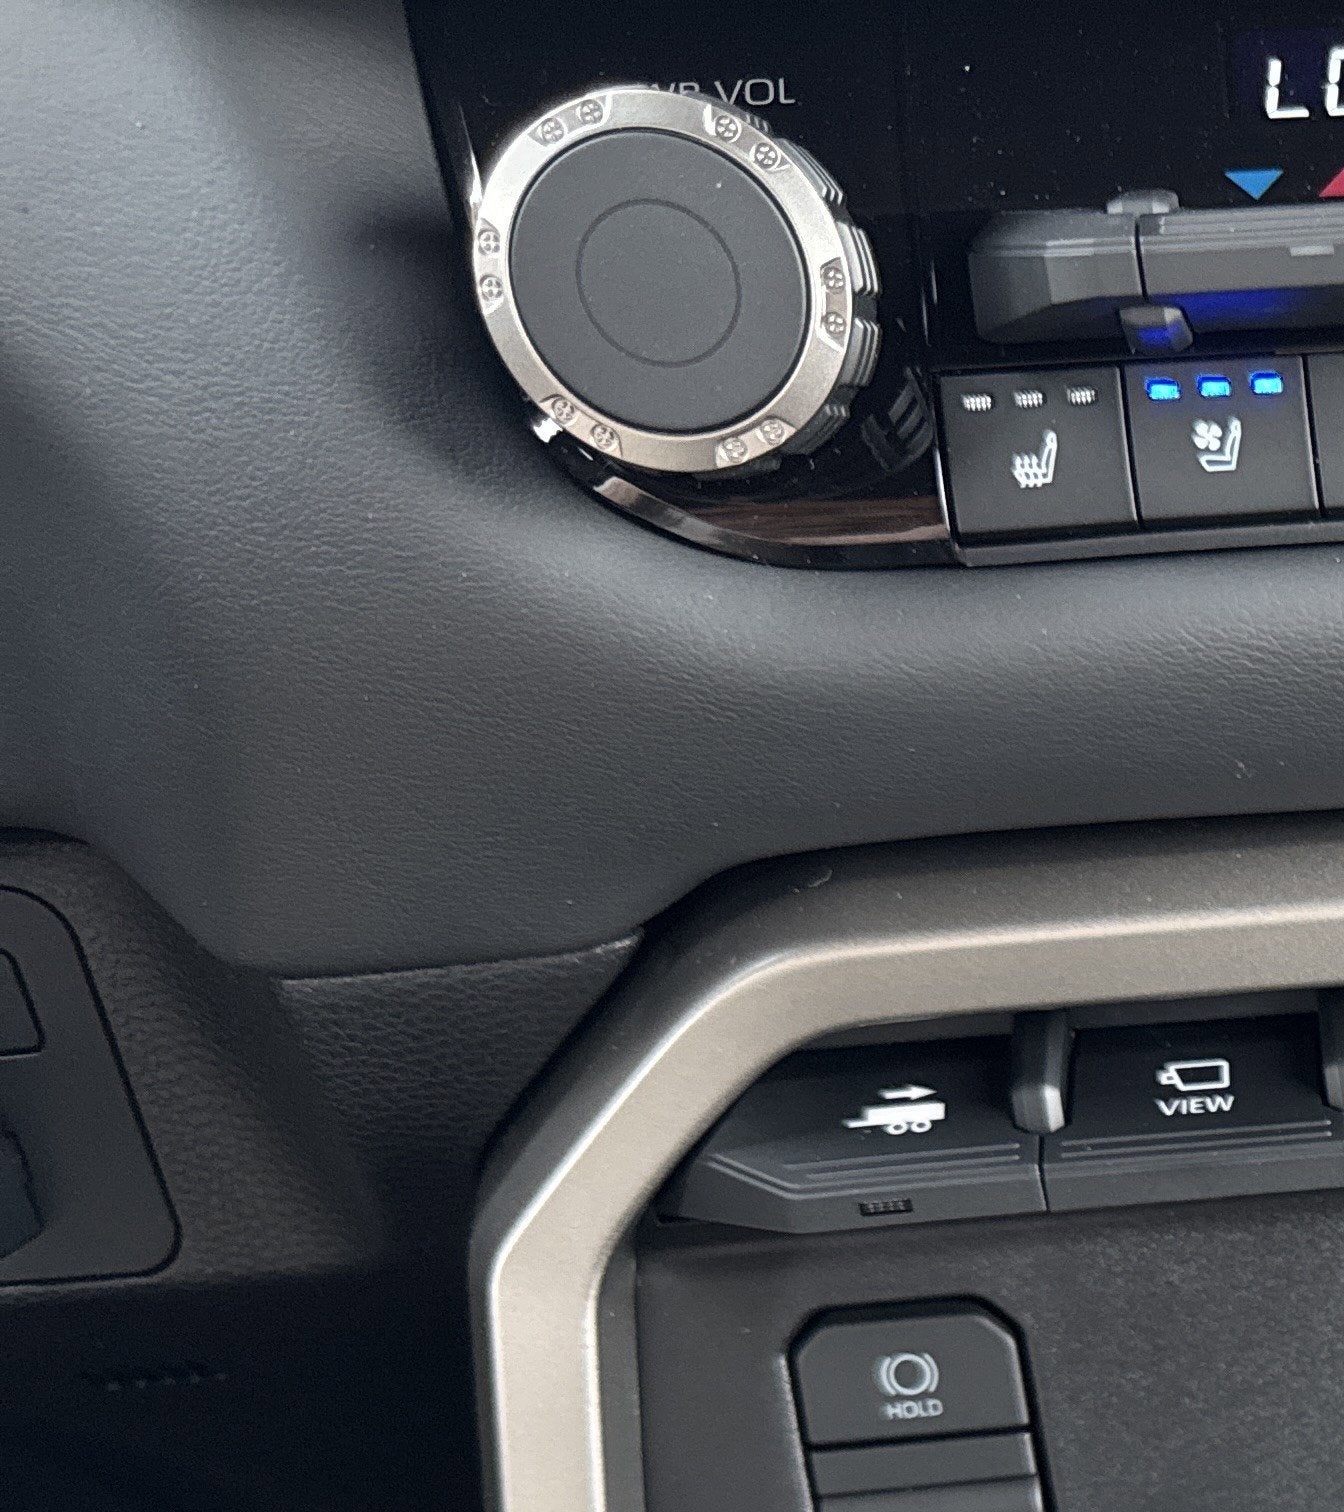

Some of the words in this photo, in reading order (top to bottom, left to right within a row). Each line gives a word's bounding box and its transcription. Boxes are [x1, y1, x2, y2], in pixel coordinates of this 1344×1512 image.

[714, 78, 796, 106] VOL
[1156, 1095, 1235, 1116] VIEW
[883, 1398, 944, 1420] HOLD
